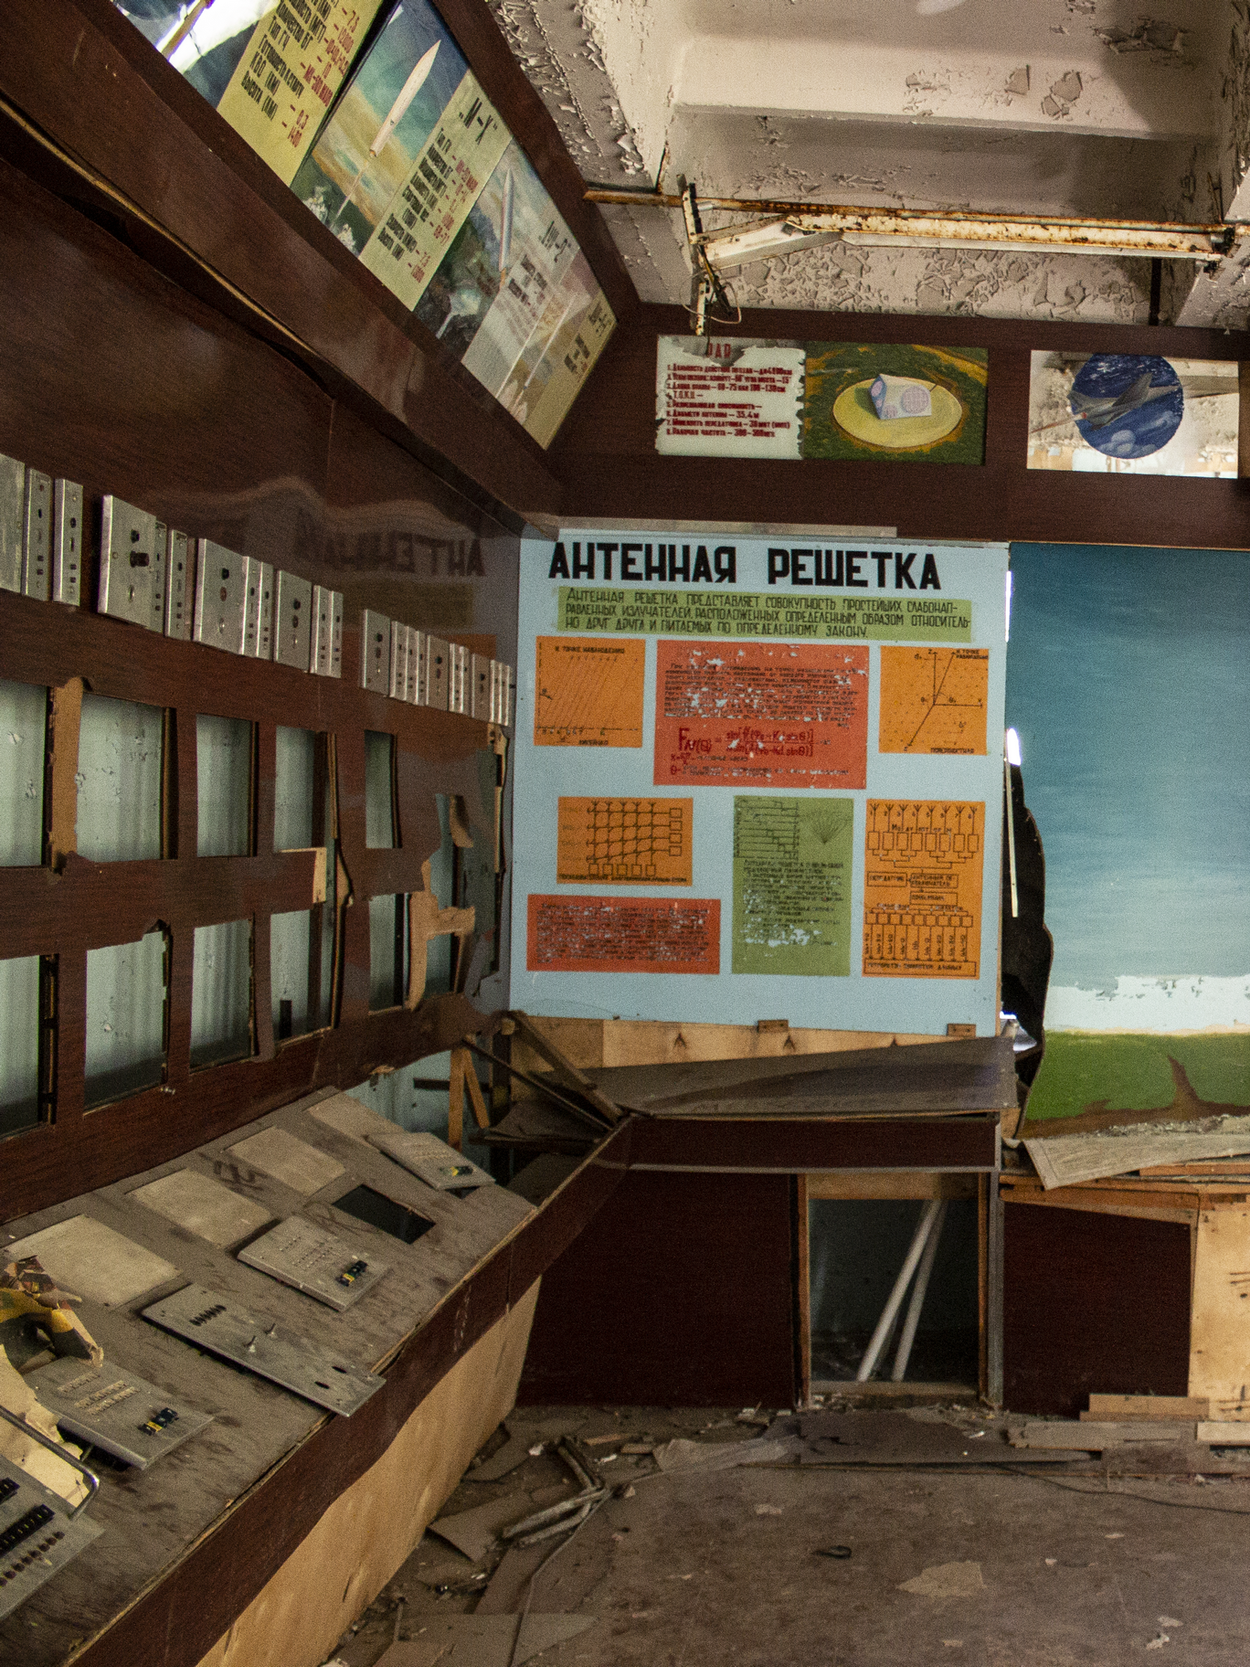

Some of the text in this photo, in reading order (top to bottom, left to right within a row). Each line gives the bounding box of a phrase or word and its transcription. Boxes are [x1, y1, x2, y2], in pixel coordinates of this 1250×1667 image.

[548, 541, 942, 590] АНТЕННАЯ РЕШЕТКА
[687, 593, 759, 608] ПРЕДСТАВЛЯЕТ
[765, 598, 836, 610] СОВОКУПНОСТЬ
[566, 617, 579, 629] НО
[586, 617, 610, 630] ДРУГ
[615, 618, 645, 631] ДРУГА
[650, 620, 657, 631] И
[661, 620, 712, 633] ПИТАЕМЫХ
[717, 622, 730, 634] ПО
[862, 613, 904, 626] ОБРАЗОМ
